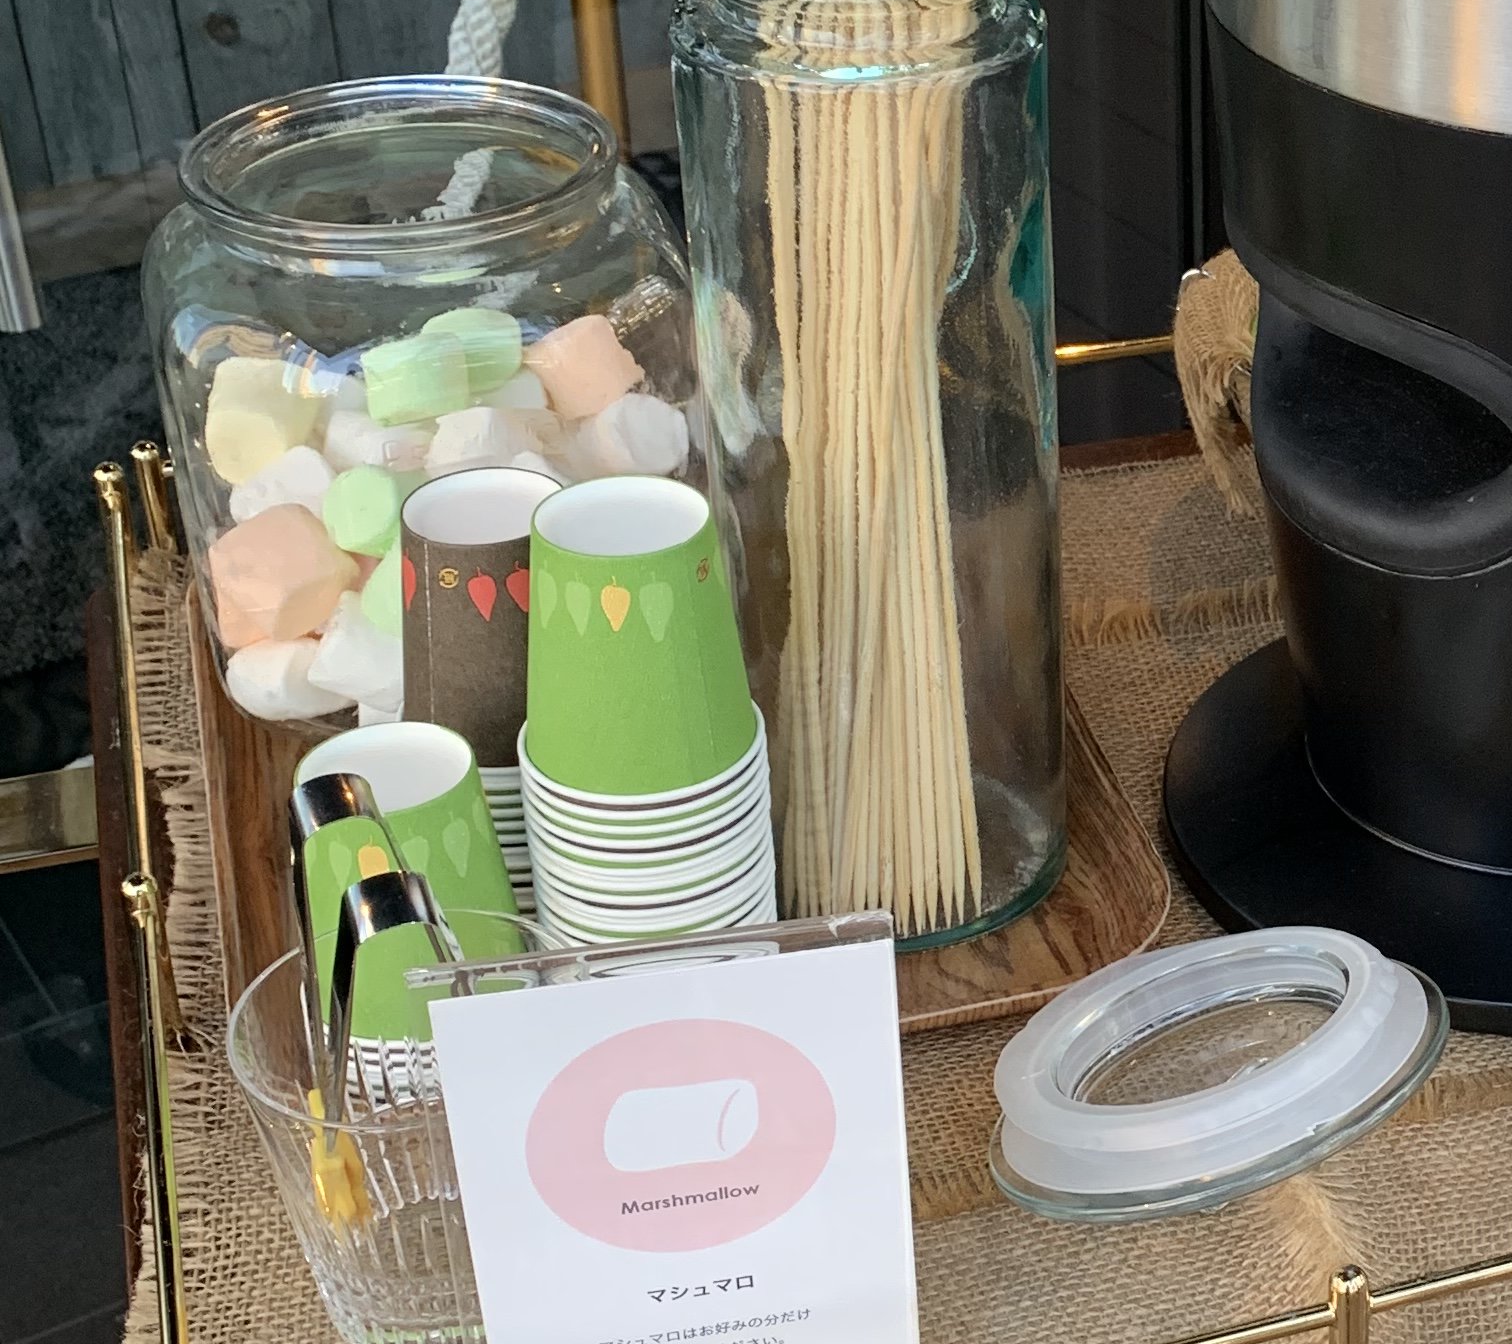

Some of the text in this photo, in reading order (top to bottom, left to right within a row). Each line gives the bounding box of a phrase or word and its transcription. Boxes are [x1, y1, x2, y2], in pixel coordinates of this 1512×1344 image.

[621, 1185, 760, 1215] Marshmallow
[647, 1275, 754, 1302] マシュマロ
